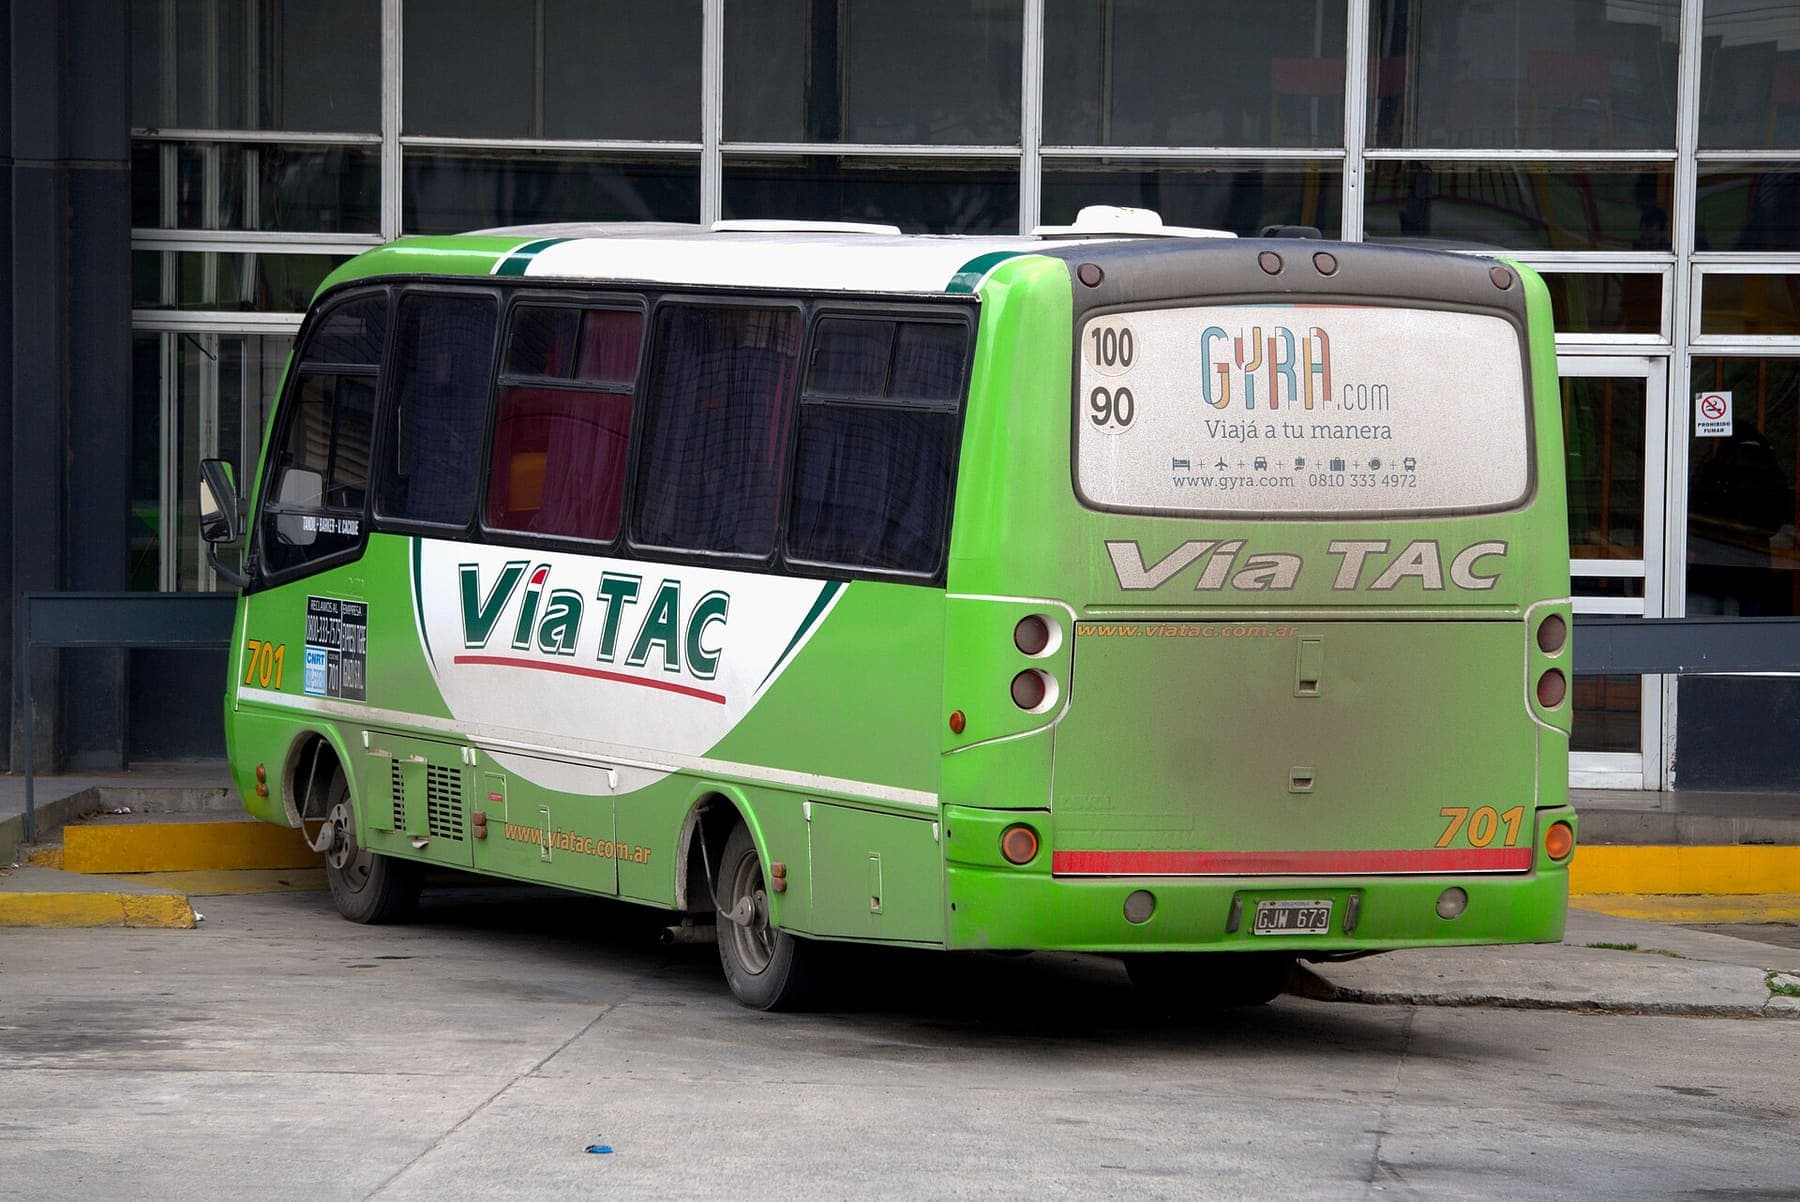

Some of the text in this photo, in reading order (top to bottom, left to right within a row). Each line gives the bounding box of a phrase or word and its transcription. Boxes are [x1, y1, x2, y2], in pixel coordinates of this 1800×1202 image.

[1092, 327, 1133, 367] 100
[1090, 386, 1134, 426] 90
[1204, 420, 1393, 443] Viajá a tu manera
[1172, 473, 1417, 490] www.gyra.com 0810 333 4972
[1104, 538, 1509, 592] Via TAC
[1076, 622, 1298, 638] www.viatac.com.ar
[245, 639, 286, 690] 701
[306, 652, 325, 666] CNRT
[504, 822, 652, 865] www.viatac.com.ar
[1435, 805, 1525, 848] 701
[1258, 909, 1328, 928] GJW 673
